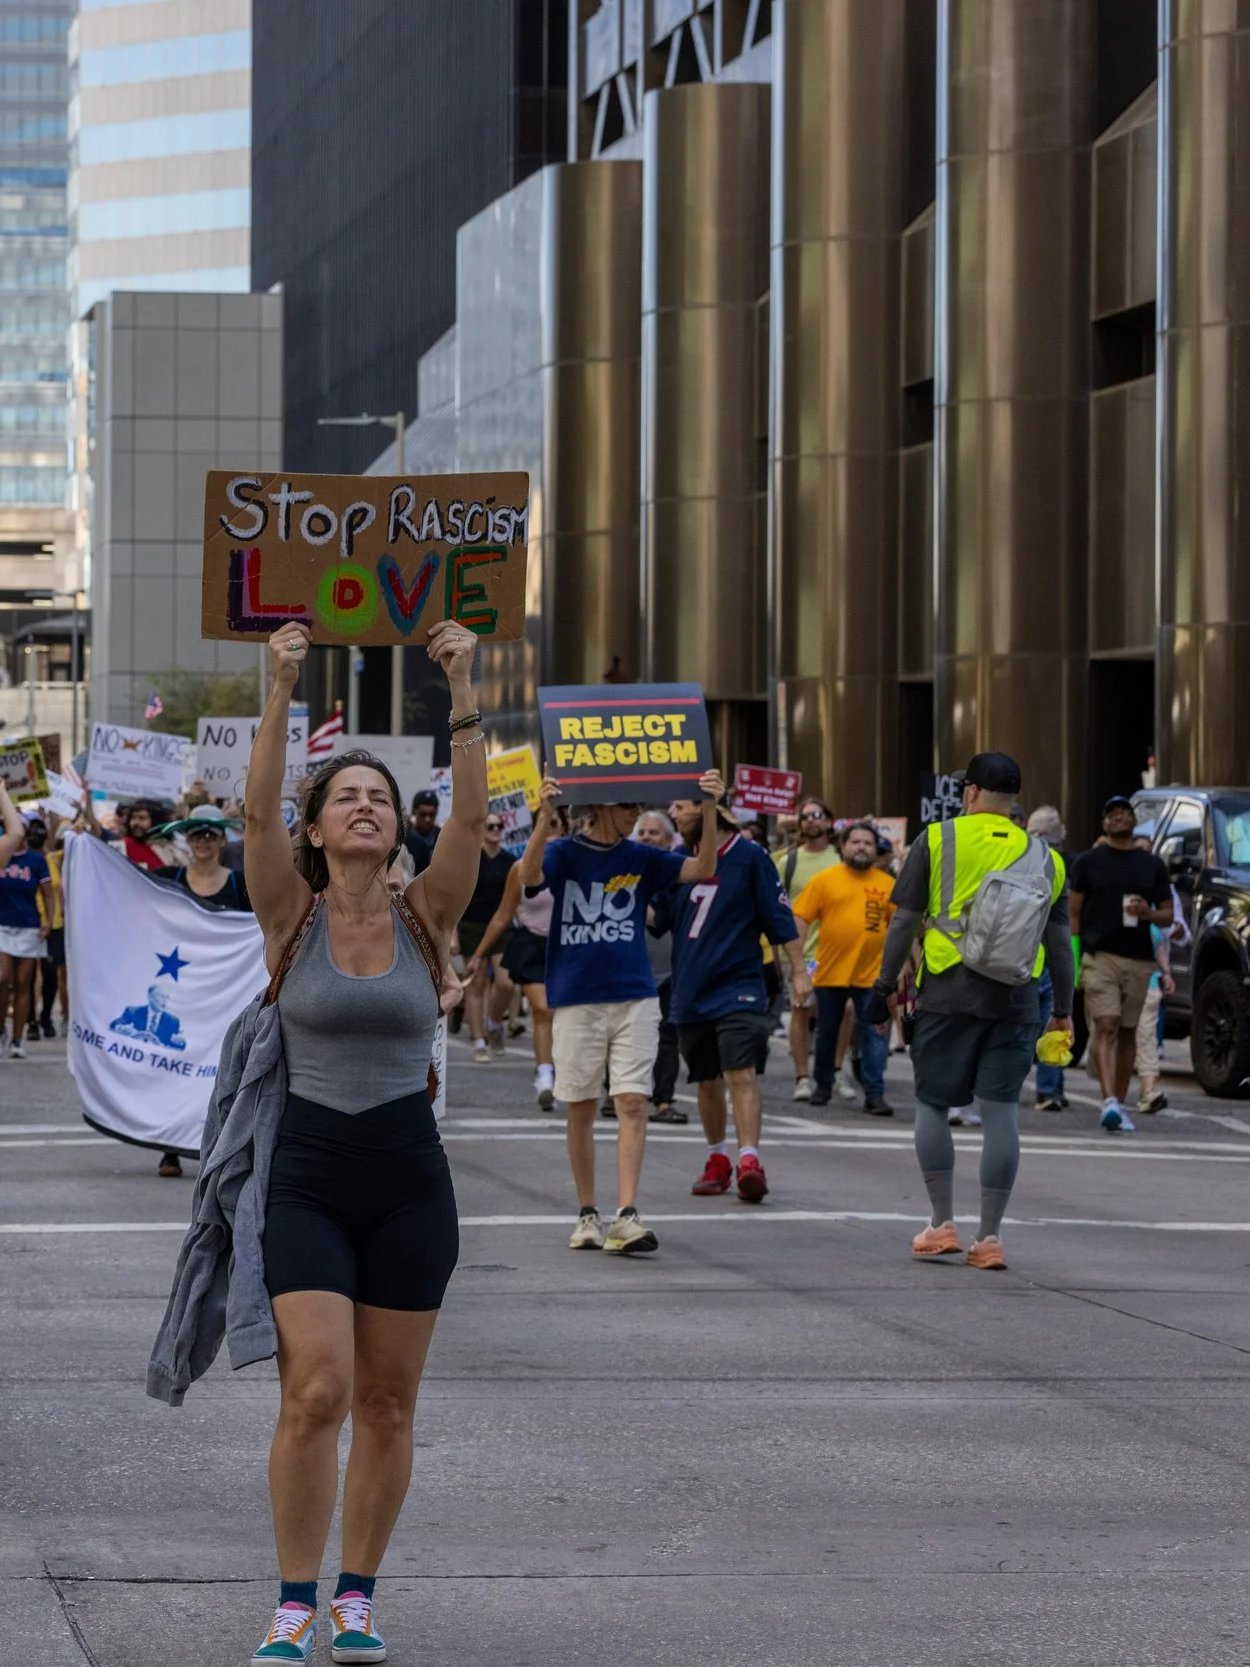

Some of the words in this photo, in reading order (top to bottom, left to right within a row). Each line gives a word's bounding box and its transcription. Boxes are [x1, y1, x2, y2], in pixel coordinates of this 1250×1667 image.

[227, 546, 507, 636] LOVE
[94, 727, 121, 752] NO
[202, 724, 237, 748] NO
[559, 714, 686, 740] REJECT
[555, 740, 697, 767] FASCISM
[204, 766, 231, 780] NO
[935, 774, 960, 801] ICE
[561, 873, 640, 923] NO
[688, 884, 718, 938] 7
[560, 919, 635, 945] KINGS
[107, 1042, 145, 1063] AND
[150, 1053, 194, 1077] TAKE
